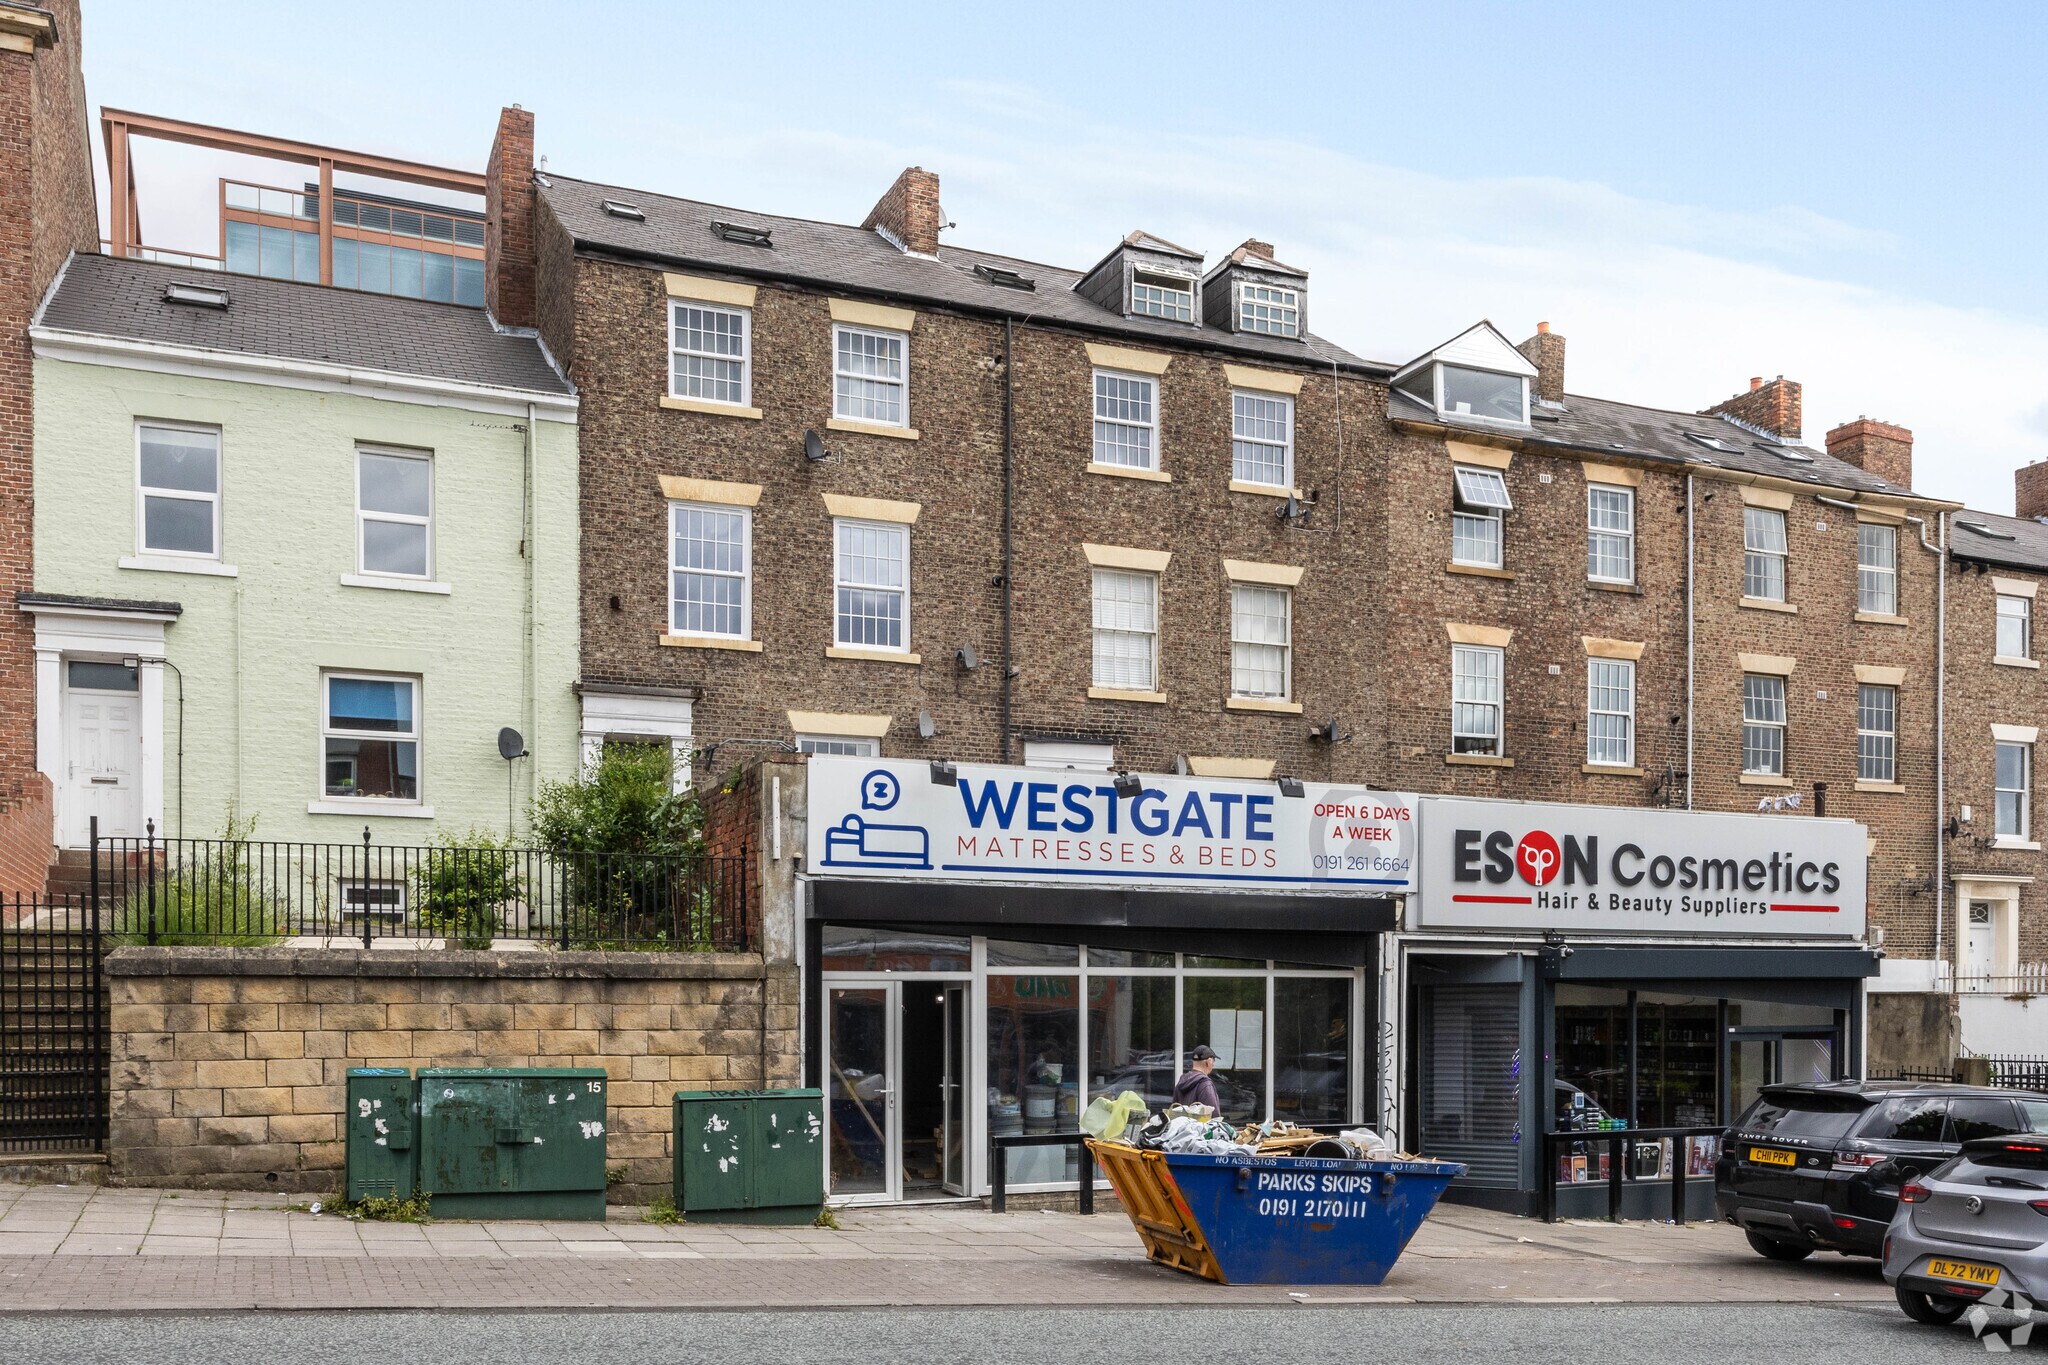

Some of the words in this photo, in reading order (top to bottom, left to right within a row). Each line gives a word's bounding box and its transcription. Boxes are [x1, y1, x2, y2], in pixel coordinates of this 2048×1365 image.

[957, 778, 1275, 842] WESTGATE
[1313, 803, 1356, 819] OPEN
[1360, 805, 1369, 819] 6
[1373, 806, 1410, 821] DAYS
[1332, 825, 1344, 839] A
[1348, 826, 1392, 842] WEEK
[956, 835, 1156, 865] MATRESSES
[1169, 844, 1185, 865] &
[1199, 845, 1277, 869] BEDS
[1313, 854, 1342, 870] 0191
[1347, 855, 1369, 871] 261
[1373, 857, 1410, 872] 6664
[1611, 843, 1840, 897] Cosmetics
[1538, 891, 1580, 910] Hair
[1587, 892, 1600, 910] &
[1609, 893, 1673, 916] Beauty
[1681, 895, 1767, 917] Suppliers
[586, 1081, 602, 1093] 15
[1737, 1132, 1767, 1141] RANGE
[1771, 1136, 1809, 1145] ROVER
[1215, 1155, 1229, 1164] NO
[1231, 1157, 1278, 1167] ASBESTOS
[1294, 1159, 1320, 1168] LEVEL
[1773, 1151, 1790, 1163] PPK
[1390, 1162, 1403, 1171] NO
[1258, 1172, 1316, 1192] PARKS
[1321, 1174, 1373, 1194] SKIPS
[1259, 1198, 1297, 1217] 0191
[1303, 1199, 1367, 1218] 2170111
[1932, 1261, 1967, 1279] DL72
[1969, 1266, 1995, 1282] YMY
